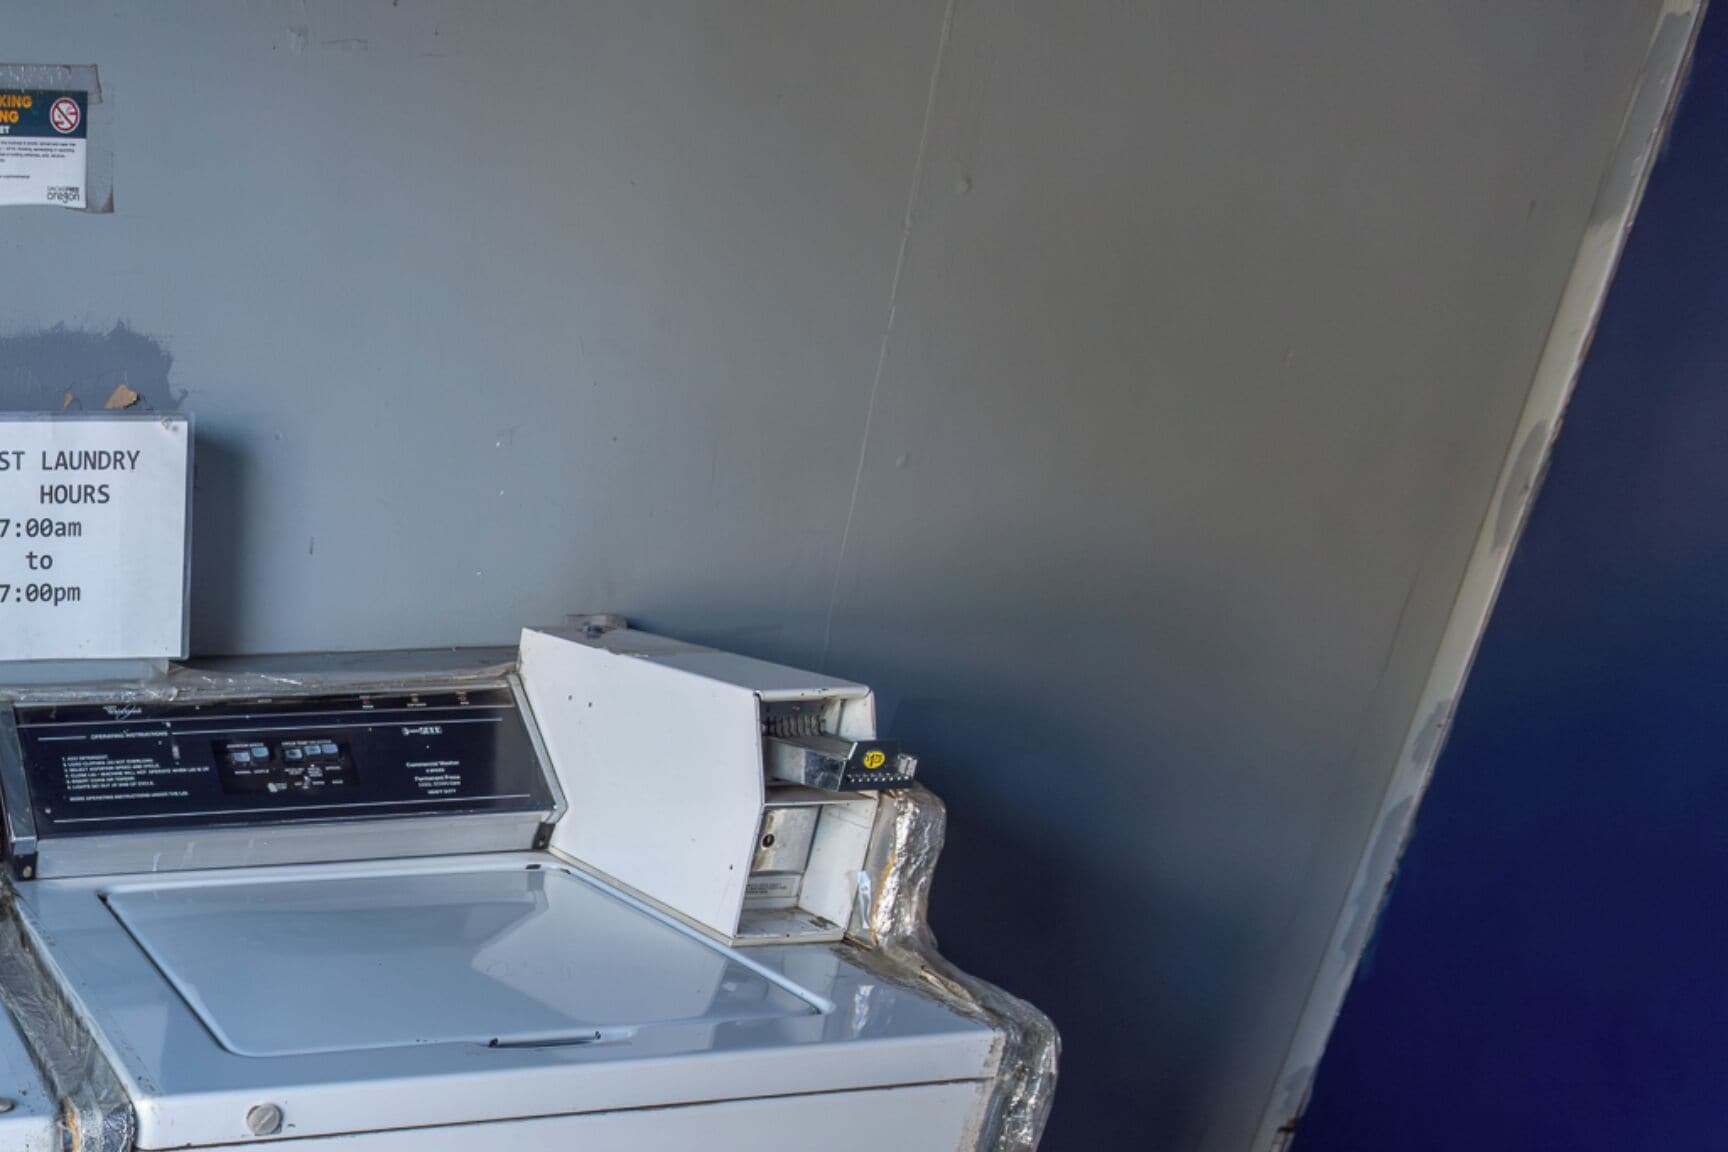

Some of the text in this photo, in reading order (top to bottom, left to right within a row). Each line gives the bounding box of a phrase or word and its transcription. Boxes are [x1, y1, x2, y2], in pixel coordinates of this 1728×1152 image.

[41, 450, 140, 471] LAUNDRY
[40, 484, 110, 504] HOURS
[26, 551, 53, 570] to
